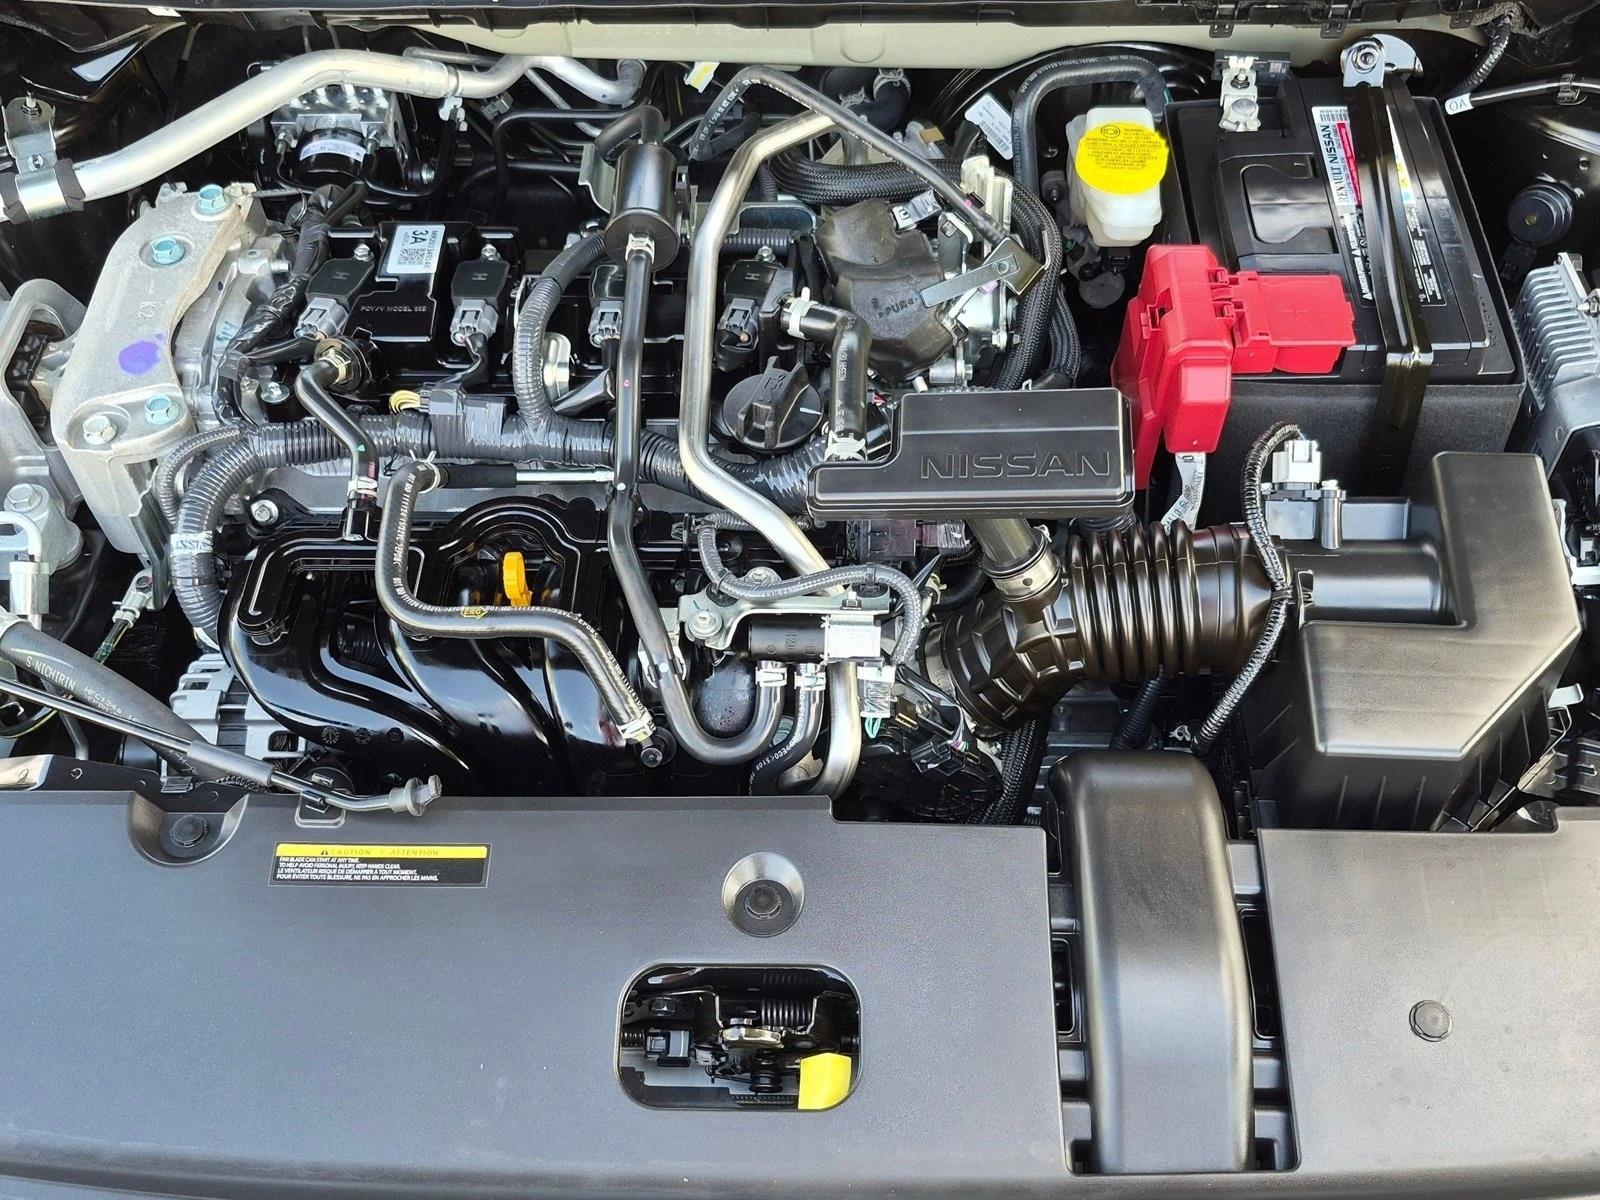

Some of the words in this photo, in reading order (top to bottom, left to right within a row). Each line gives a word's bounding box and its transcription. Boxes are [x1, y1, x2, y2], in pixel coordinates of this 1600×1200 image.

[1320, 125, 1339, 164] NISSAN
[410, 230, 429, 245] 3A
[920, 451, 1110, 479] NISSAN
